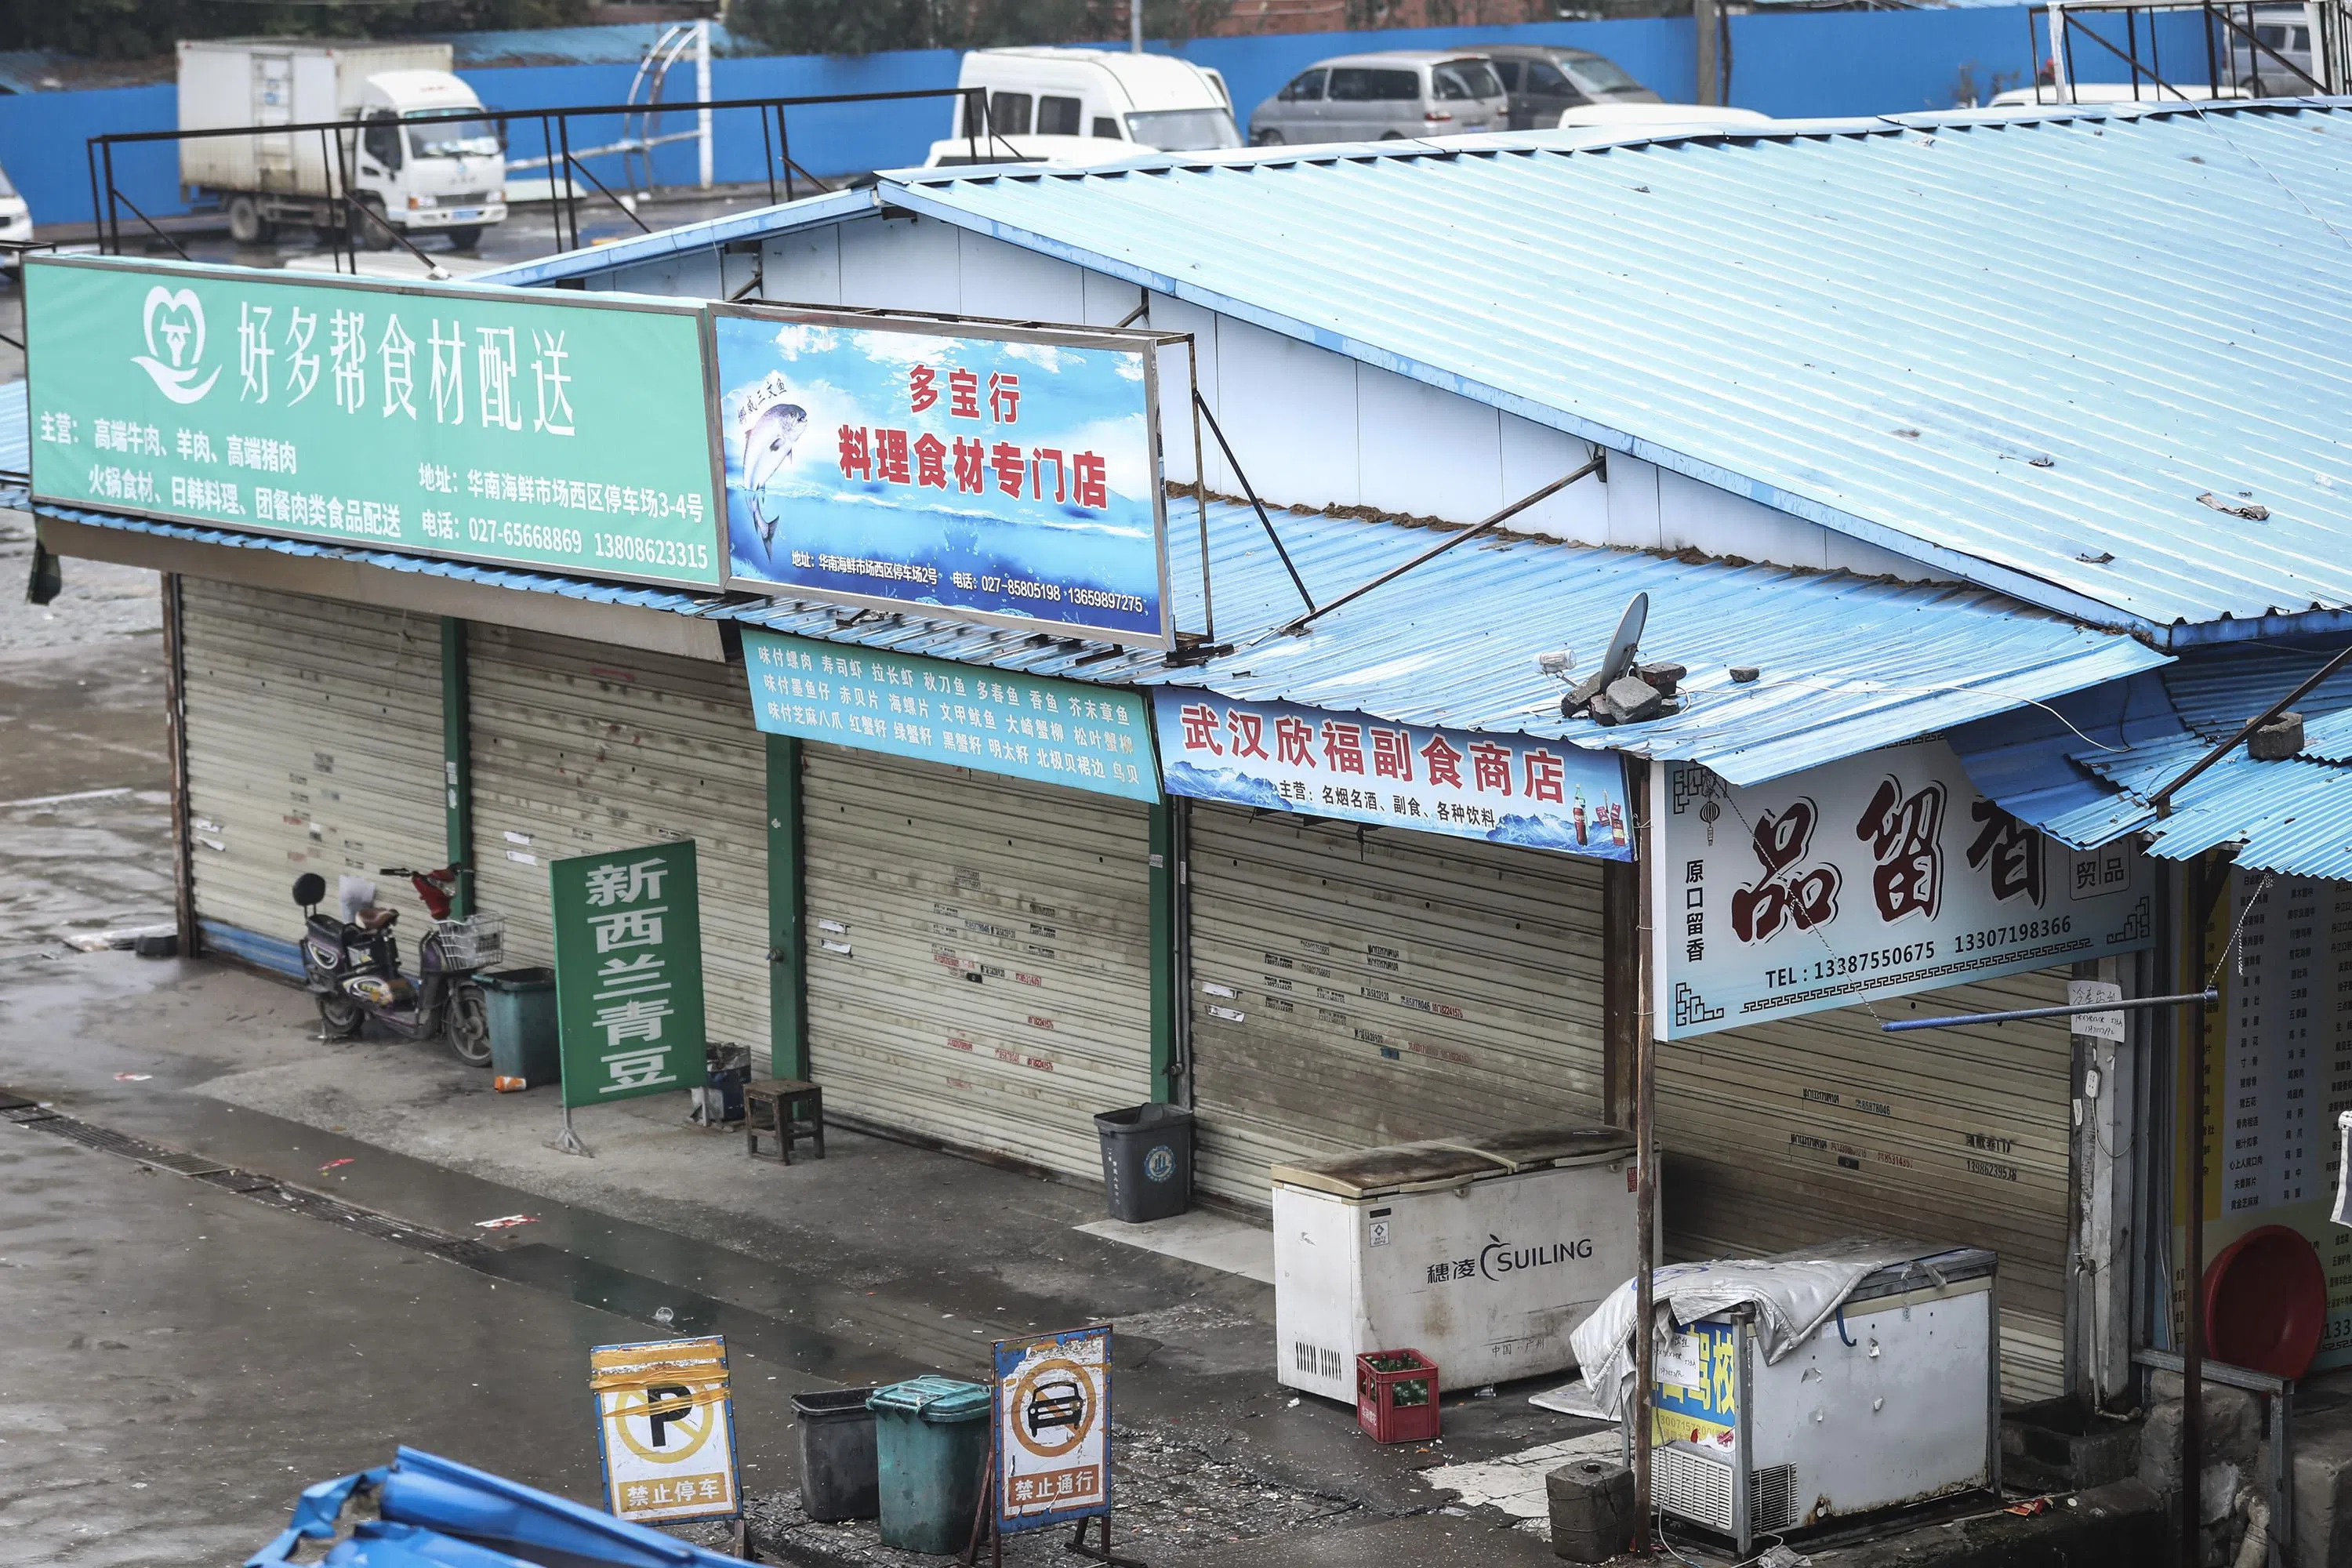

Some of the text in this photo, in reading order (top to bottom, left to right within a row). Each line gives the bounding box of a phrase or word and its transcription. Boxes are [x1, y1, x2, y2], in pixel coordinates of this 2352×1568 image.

[238, 301, 575, 436] 好多帮食材配送
[909, 363, 1021, 424] 多宝行
[94, 418, 296, 475] 高端牛肉、羊肉、高端猪肉
[838, 424, 1108, 510] 料理食材专门店
[89, 464, 401, 538] 火锅食材、日韩料理、团餐肉类食品配送
[594, 532, 708, 570] 13808623315
[1069, 587, 1143, 613] 13659897275
[757, 646, 1130, 726] 味付螺肉 寿司虾 拉长虾 秋刀鱼 多春鱼 香鱼 芥末章鱼
[763, 673, 830, 701] 味付墨鱼仔
[840, 685, 879, 710] 赤贝片
[889, 693, 928, 718] 海螺片
[940, 702, 996, 730] 文甲鱿鱼
[1074, 726, 1134, 755] 松叶蟹柳
[768, 702, 843, 730] 味付芝麻八爪
[849, 713, 887, 739] 红蟹籽
[942, 731, 982, 755] 黑蟹籽
[989, 739, 1029, 765] 明太籽
[1036, 748, 1106, 779] 北极贝裙边
[1180, 703, 1566, 804] 武汉欣福副食商店
[1686, 860, 1704, 963] 原口留香
[1955, 916, 2071, 953] 13307198366
[586, 858, 677, 1094] 新西兰青豆
[1427, 1239, 1592, 1283] 穗凌 SUILING
[627, 1479, 720, 1508] 禁止停车
[1014, 1471, 1094, 1499] 禁止通行
